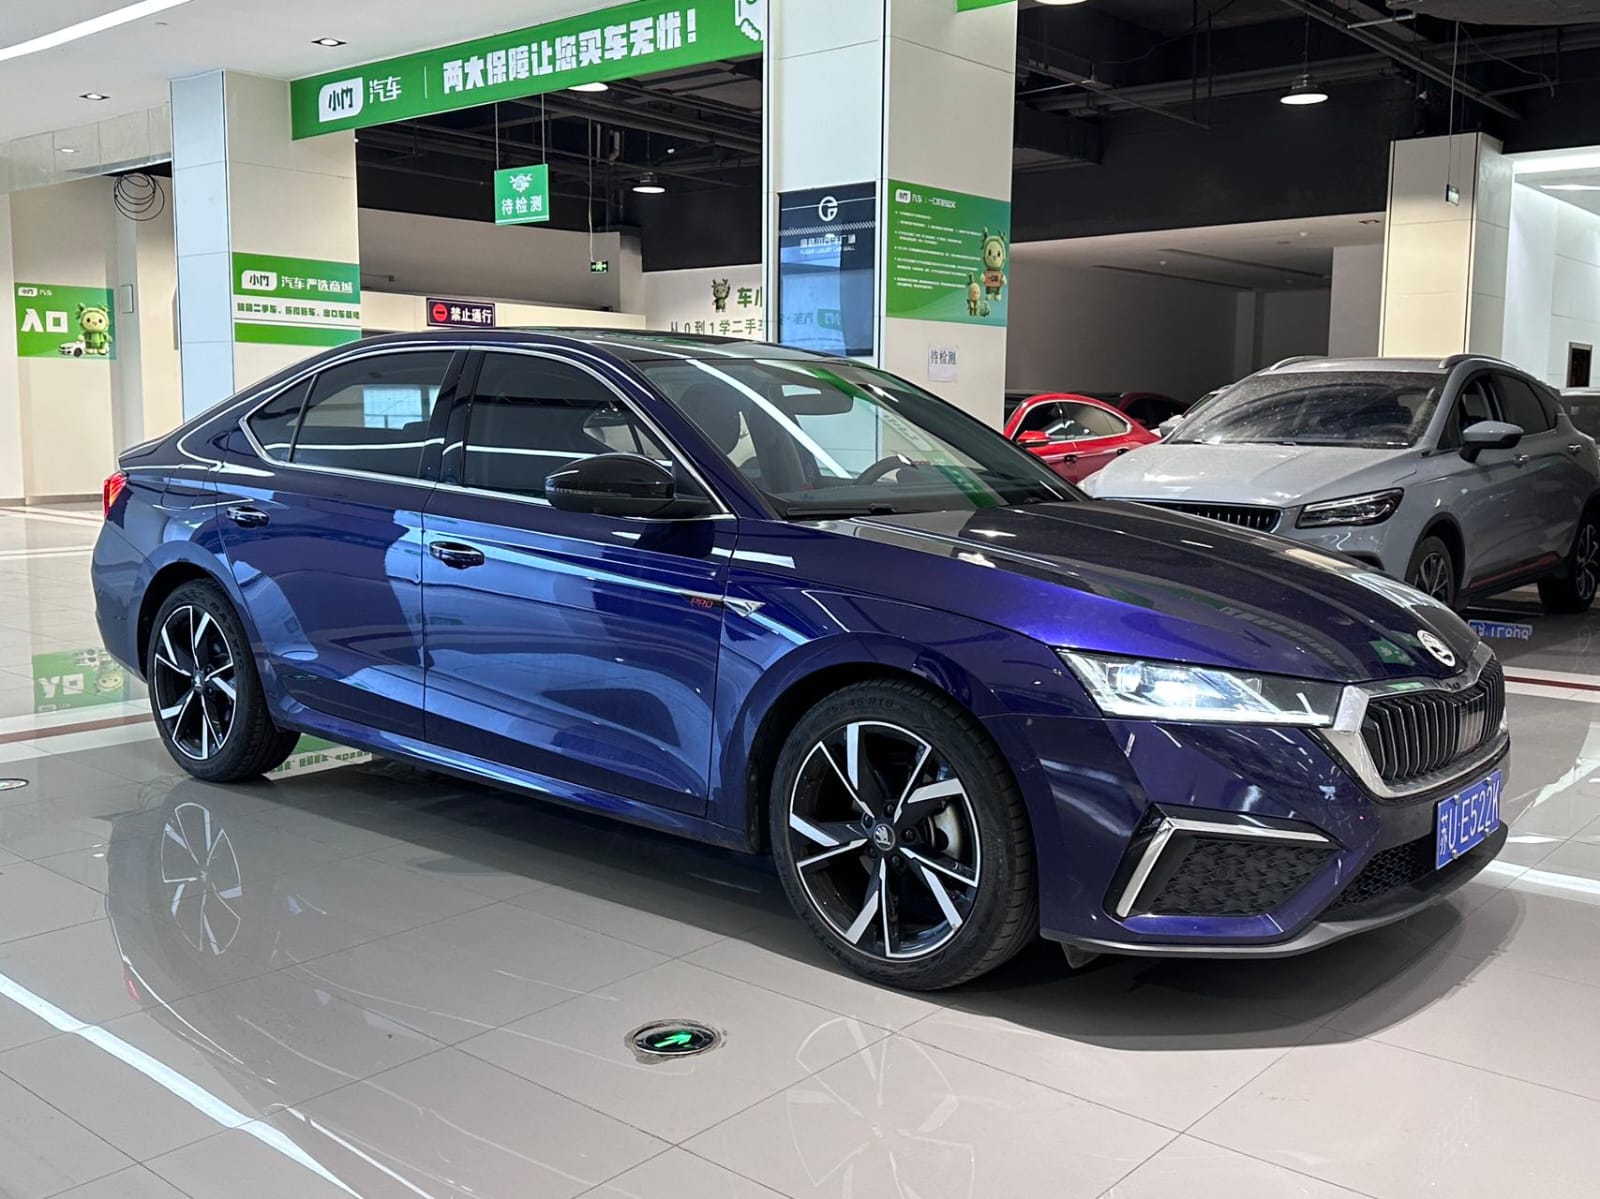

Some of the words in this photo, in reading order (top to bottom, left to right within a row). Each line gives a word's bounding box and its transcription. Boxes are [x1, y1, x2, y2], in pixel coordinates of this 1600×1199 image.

[369, 76, 402, 104] 汽车
[501, 195, 542, 215] 待检测
[281, 275, 305, 289] 汽车
[21, 308, 68, 333] 入口
[450, 306, 493, 324] 禁止通行
[930, 350, 956, 365] 待检测
[691, 597, 714, 608] PRO
